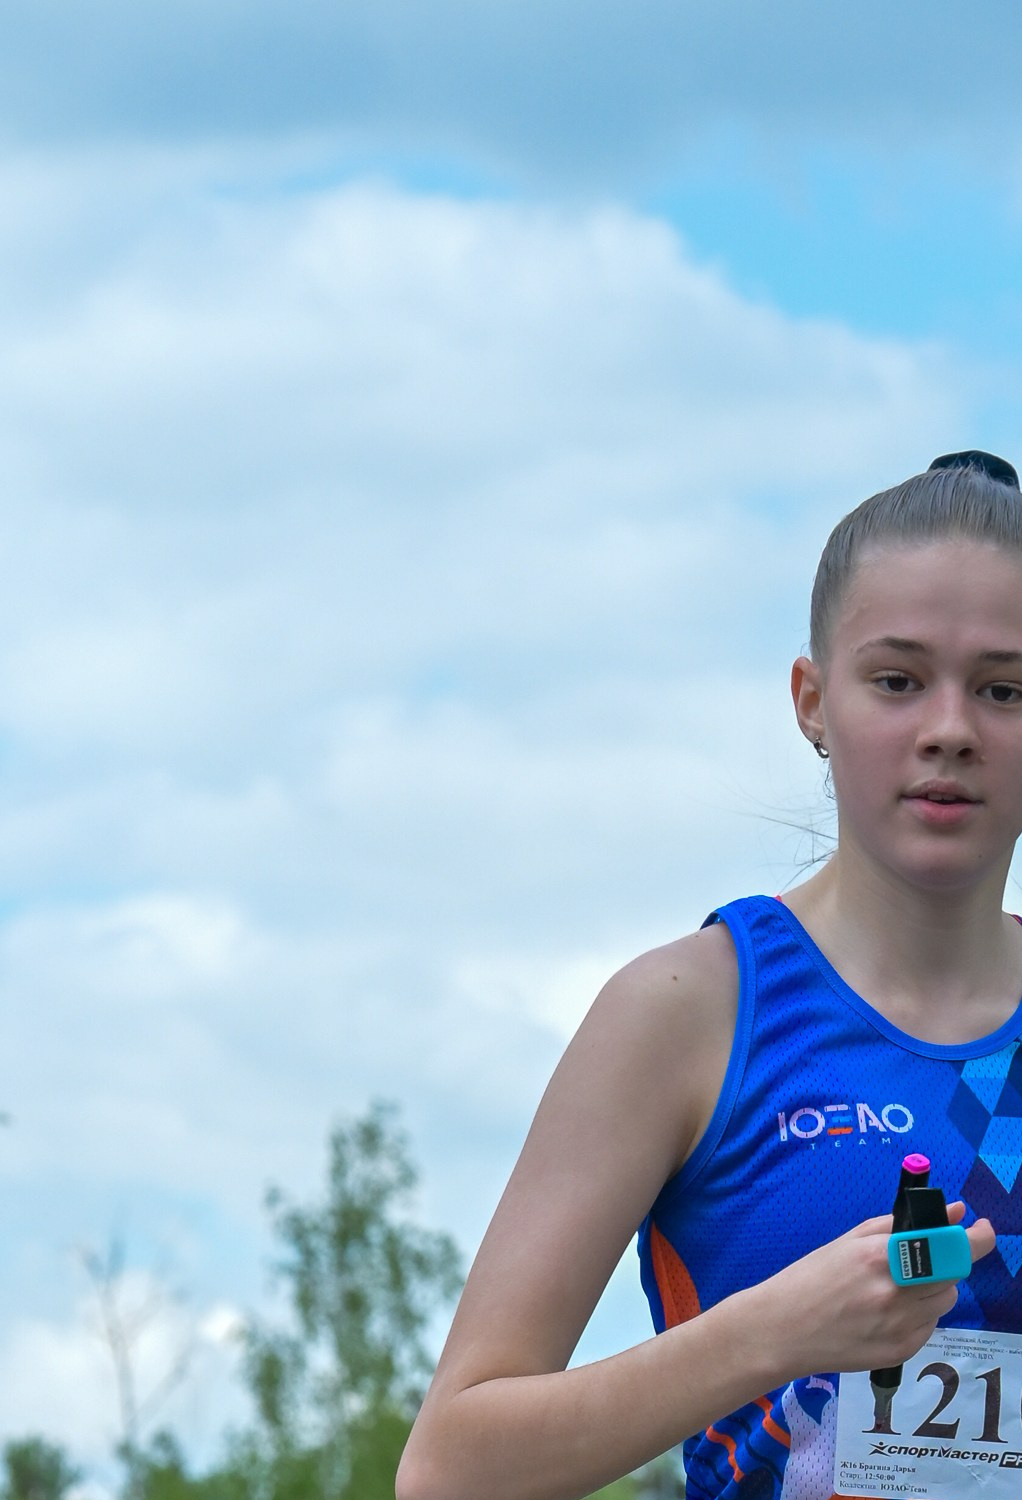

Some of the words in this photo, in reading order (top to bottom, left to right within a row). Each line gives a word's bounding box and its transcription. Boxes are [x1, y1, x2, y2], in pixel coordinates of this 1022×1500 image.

[810, 1137, 891, 1150] TEAM
[840, 1461, 857, 1469] Ж16
[859, 1462, 891, 1471] Брагина
[892, 1465, 916, 1474] Дарья
[865, 1473, 896, 1481] 12:50:00
